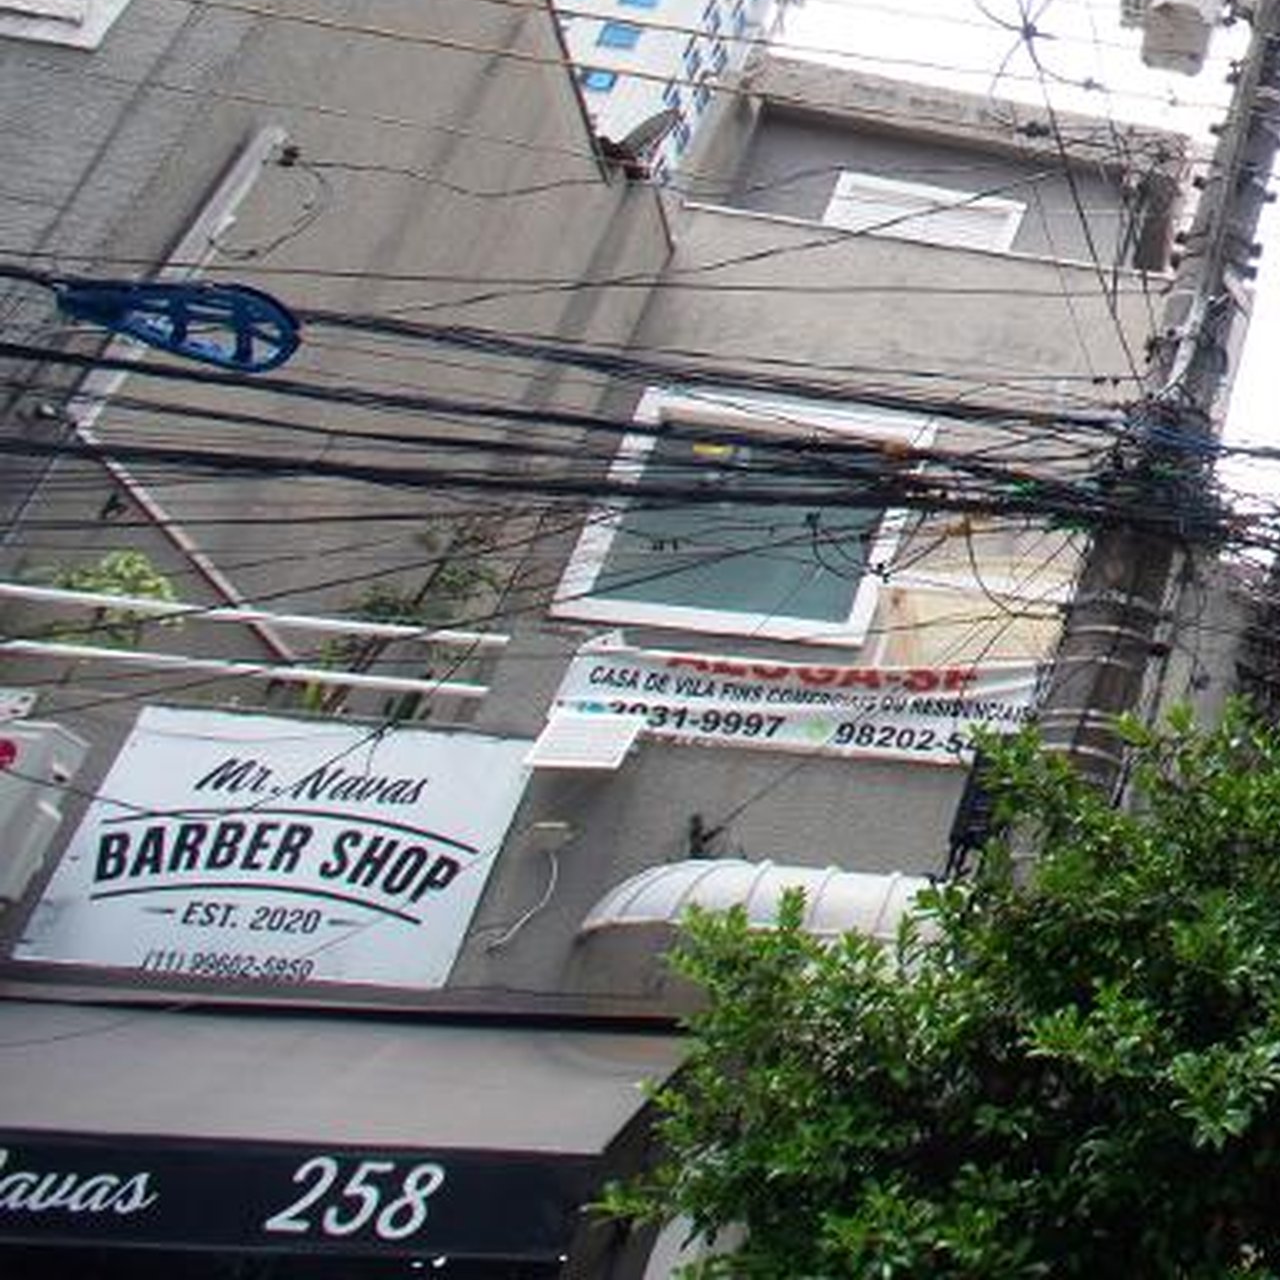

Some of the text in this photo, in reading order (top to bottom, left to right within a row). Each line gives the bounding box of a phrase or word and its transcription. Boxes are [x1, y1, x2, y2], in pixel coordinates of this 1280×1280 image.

[589, 666, 640, 690] CASA
[643, 672, 670, 694] DE
[675, 677, 715, 698] VILA
[720, 682, 764, 703] FINS
[194, 758, 428, 804] Mr. Navas
[94, 821, 462, 904] BARBER SHOP
[182, 901, 322, 934] EST. 2020
[0, 1149, 446, 1240] avas 258
